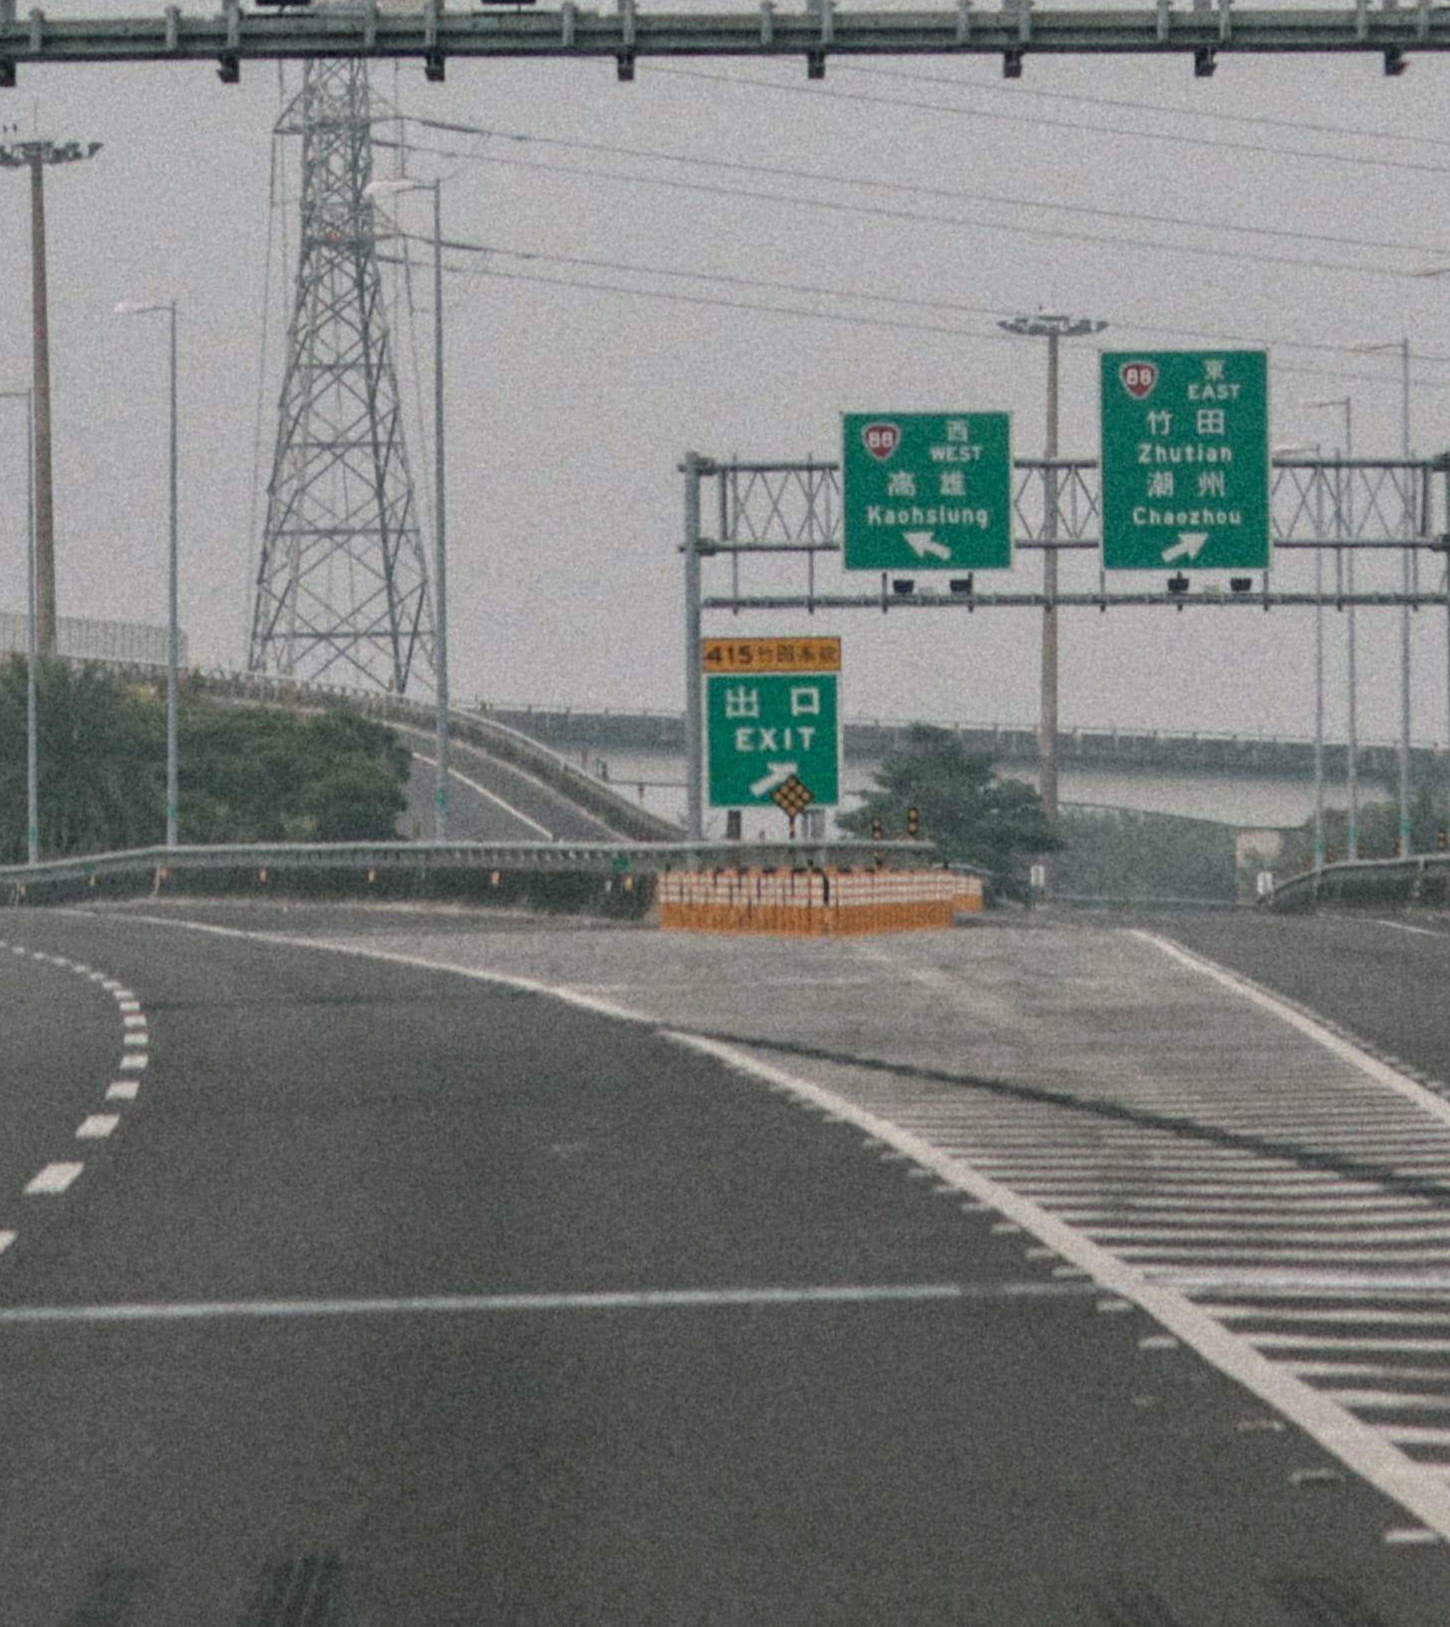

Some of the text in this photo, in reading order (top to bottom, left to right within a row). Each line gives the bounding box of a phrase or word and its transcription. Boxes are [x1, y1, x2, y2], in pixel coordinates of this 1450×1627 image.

[1125, 367, 1153, 386] 88
[1203, 359, 1226, 381] 東
[1187, 383, 1241, 401] EAST
[1146, 408, 1225, 435] 竹田
[867, 430, 895, 449] 88
[929, 445, 984, 462] WEST
[1137, 443, 1234, 464] Zhutian
[887, 470, 967, 497] 高雄
[866, 504, 989, 530] Kaohsiung
[1132, 506, 1243, 525] Chaozhou
[706, 644, 753, 665] 415
[724, 684, 821, 719] 出口
[735, 726, 816, 752] EXIT
